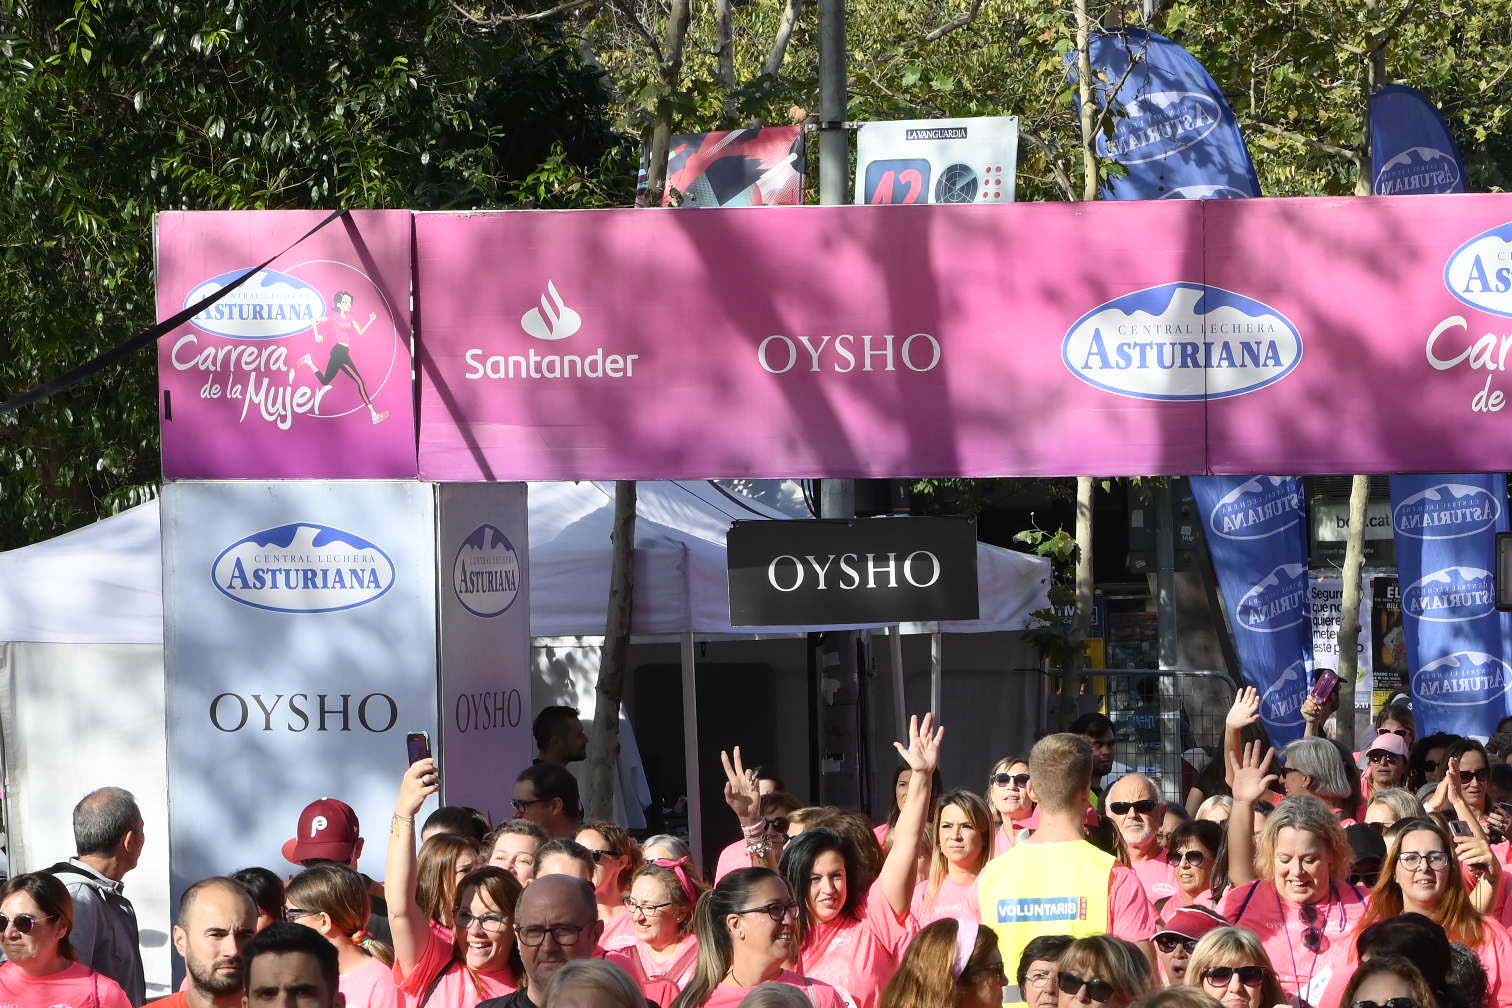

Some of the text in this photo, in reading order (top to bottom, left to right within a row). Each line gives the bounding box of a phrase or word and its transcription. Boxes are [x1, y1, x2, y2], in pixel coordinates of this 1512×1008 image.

[1081, 327, 1284, 370] ASTURIANA
[1117, 322, 1277, 336] CENTRAL LECHERA
[171, 333, 289, 372] Carrera
[464, 346, 639, 380] Santander
[757, 333, 941, 375] OYSHO
[200, 368, 333, 430] de la Mujer
[1471, 375, 1506, 413] de
[226, 557, 383, 590] ASTURIANA
[254, 554, 376, 564] CENTRAL LECHERA
[458, 558, 517, 595] ASTURIANA
[768, 549, 941, 593] OYSHO
[209, 692, 398, 733] OYSHO
[455, 688, 522, 733] OYSHO
